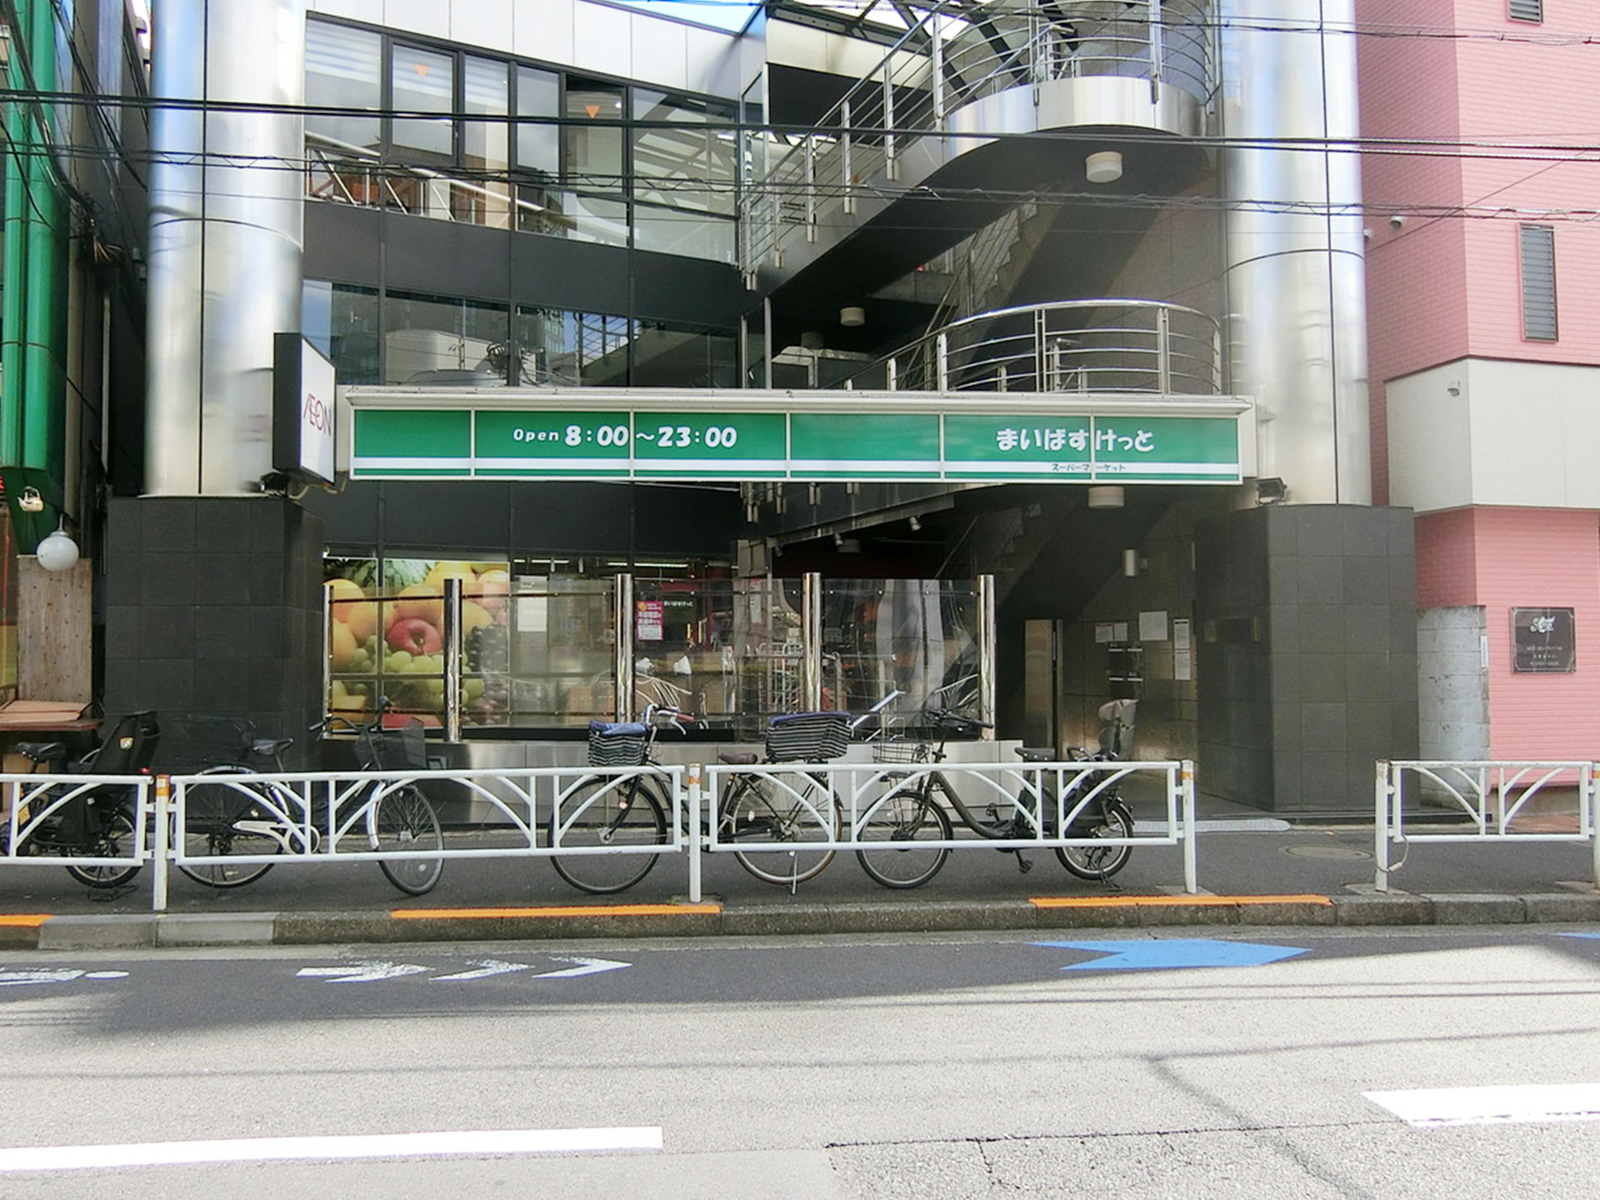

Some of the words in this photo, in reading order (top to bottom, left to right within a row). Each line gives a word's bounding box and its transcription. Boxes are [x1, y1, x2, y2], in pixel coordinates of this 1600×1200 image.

[513, 428, 559, 442] Open
[996, 428, 1155, 452] まいばすけっと
[1051, 463, 1127, 472] スーパーマーケット
